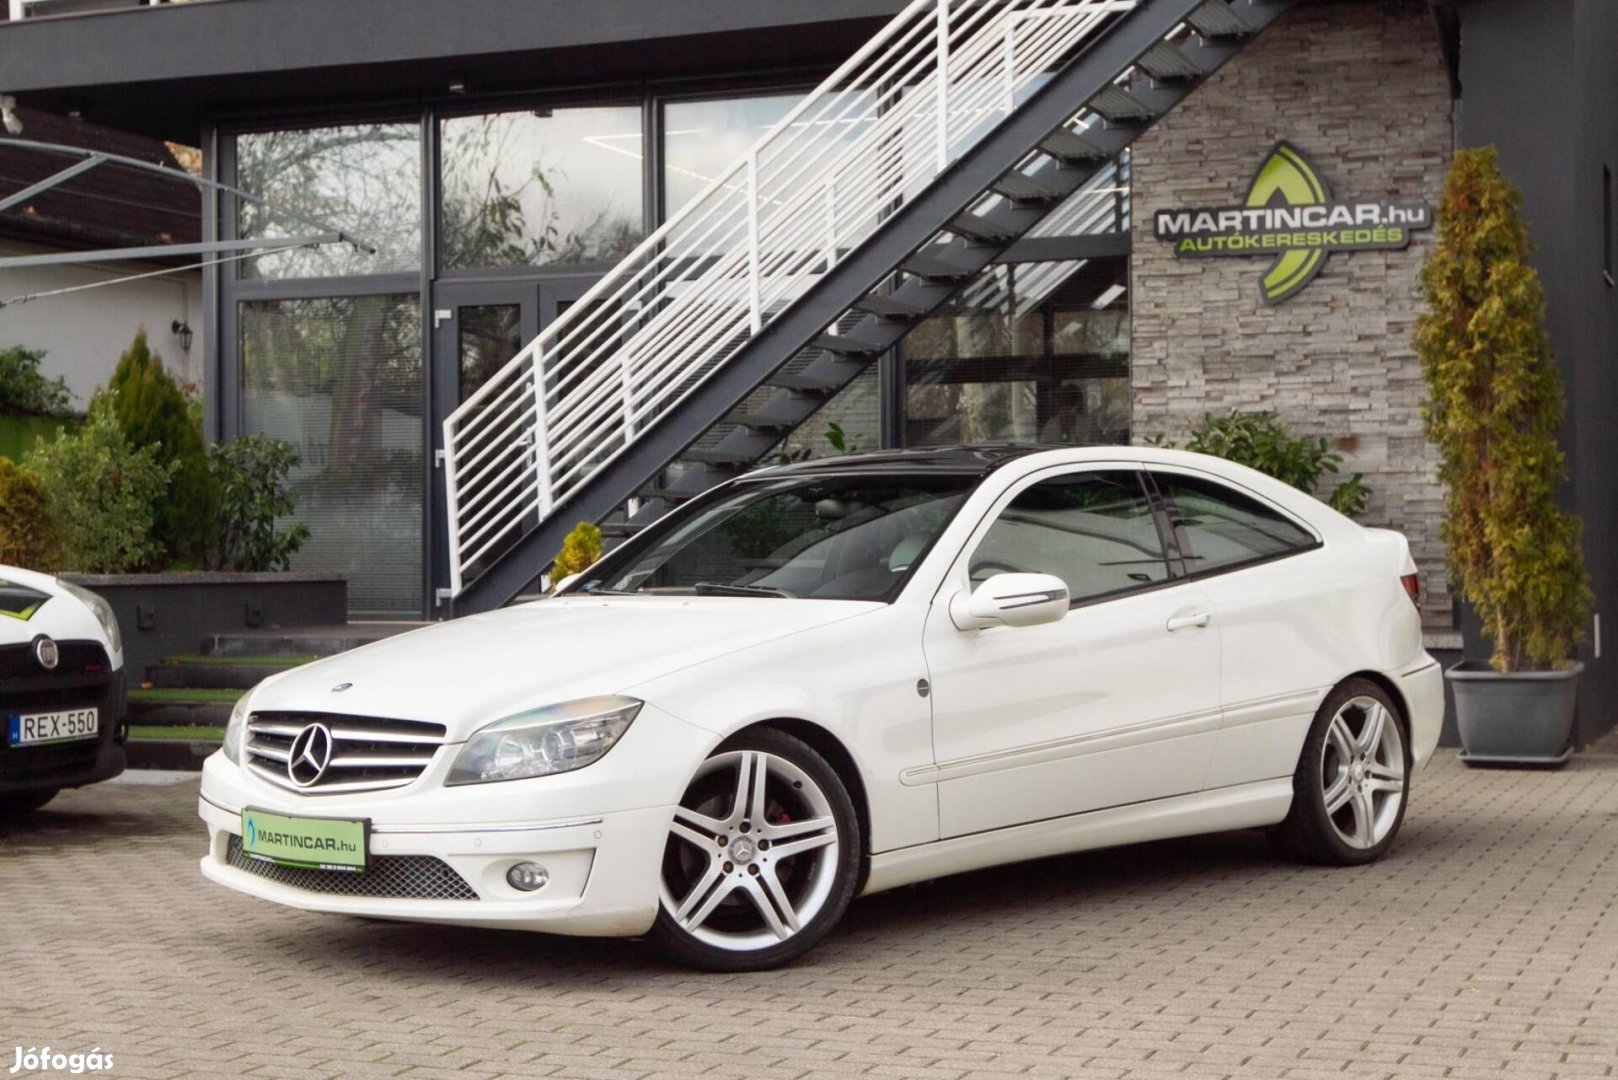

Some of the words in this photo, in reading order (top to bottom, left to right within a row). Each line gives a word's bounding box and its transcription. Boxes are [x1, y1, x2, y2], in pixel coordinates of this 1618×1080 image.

[1158, 204, 1425, 234] MARTINCAR.hu
[1179, 225, 1403, 252] AUTÓKERESKEDÉS
[24, 711, 95, 740] REX-550
[257, 829, 357, 852] MARTINCAR.hu
